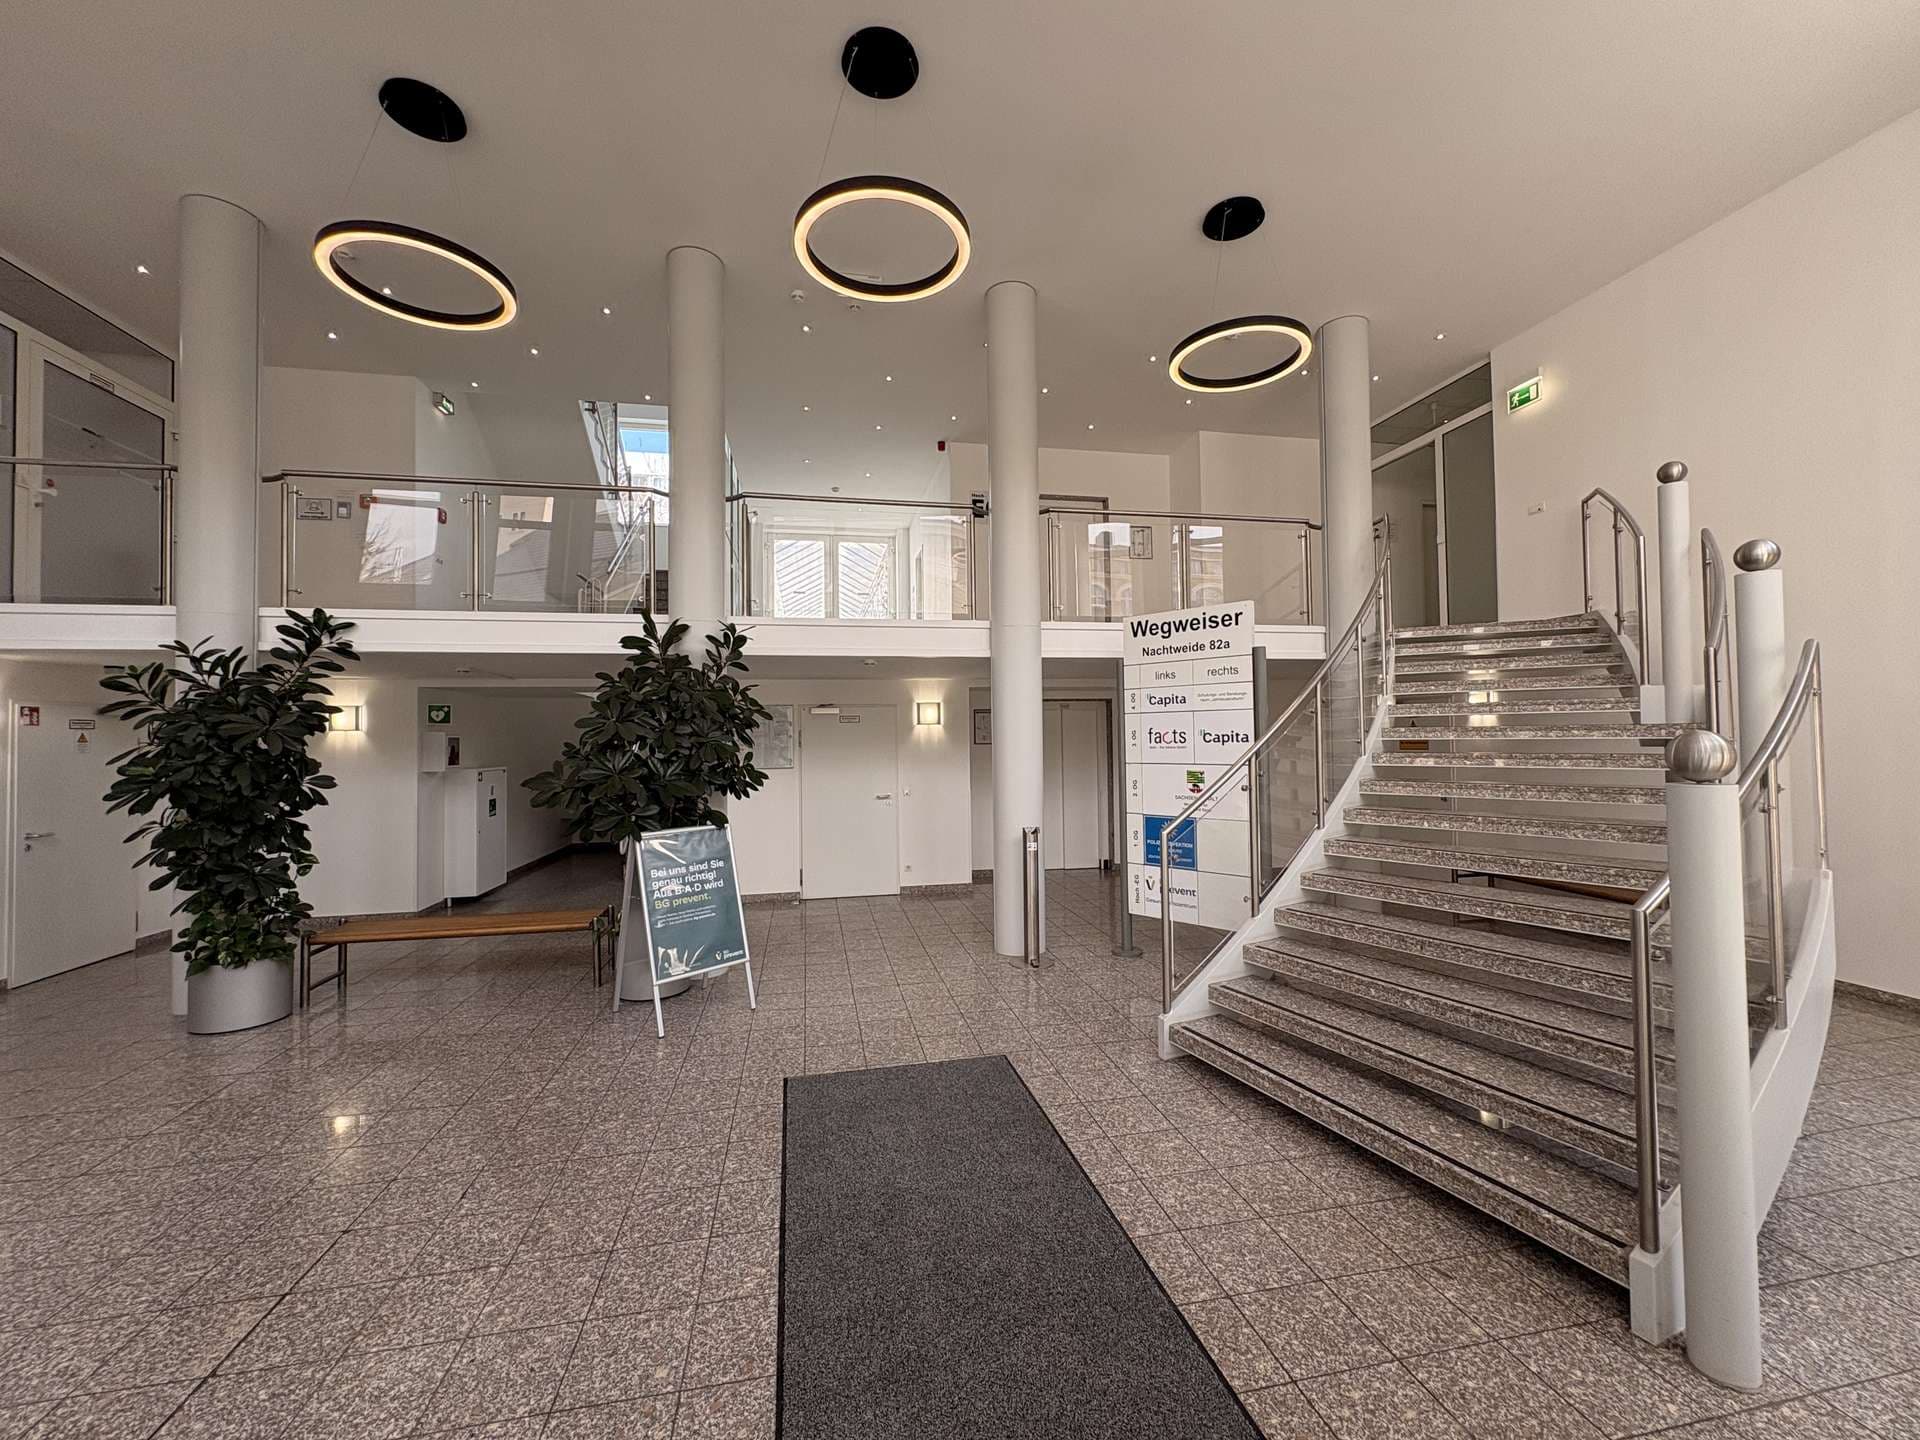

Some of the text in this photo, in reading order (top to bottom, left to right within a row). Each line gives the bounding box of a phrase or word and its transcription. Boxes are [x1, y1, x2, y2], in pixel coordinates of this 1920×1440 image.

[1130, 611, 1243, 639] Wegweiser
[1142, 640, 1230, 657] Nachtweide 82a
[1155, 670, 1176, 680] links
[1207, 666, 1239, 676] rechts
[1148, 694, 1186, 707] Capita
[1148, 728, 1186, 744] facts
[1202, 729, 1249, 746] Capita
[651, 859, 724, 878] Bei uns sind Sie
[652, 870, 716, 890] genau richtig!
[654, 889, 672, 900] Aus
[704, 879, 724, 890] wird
[655, 894, 712, 909] BG prevent.
